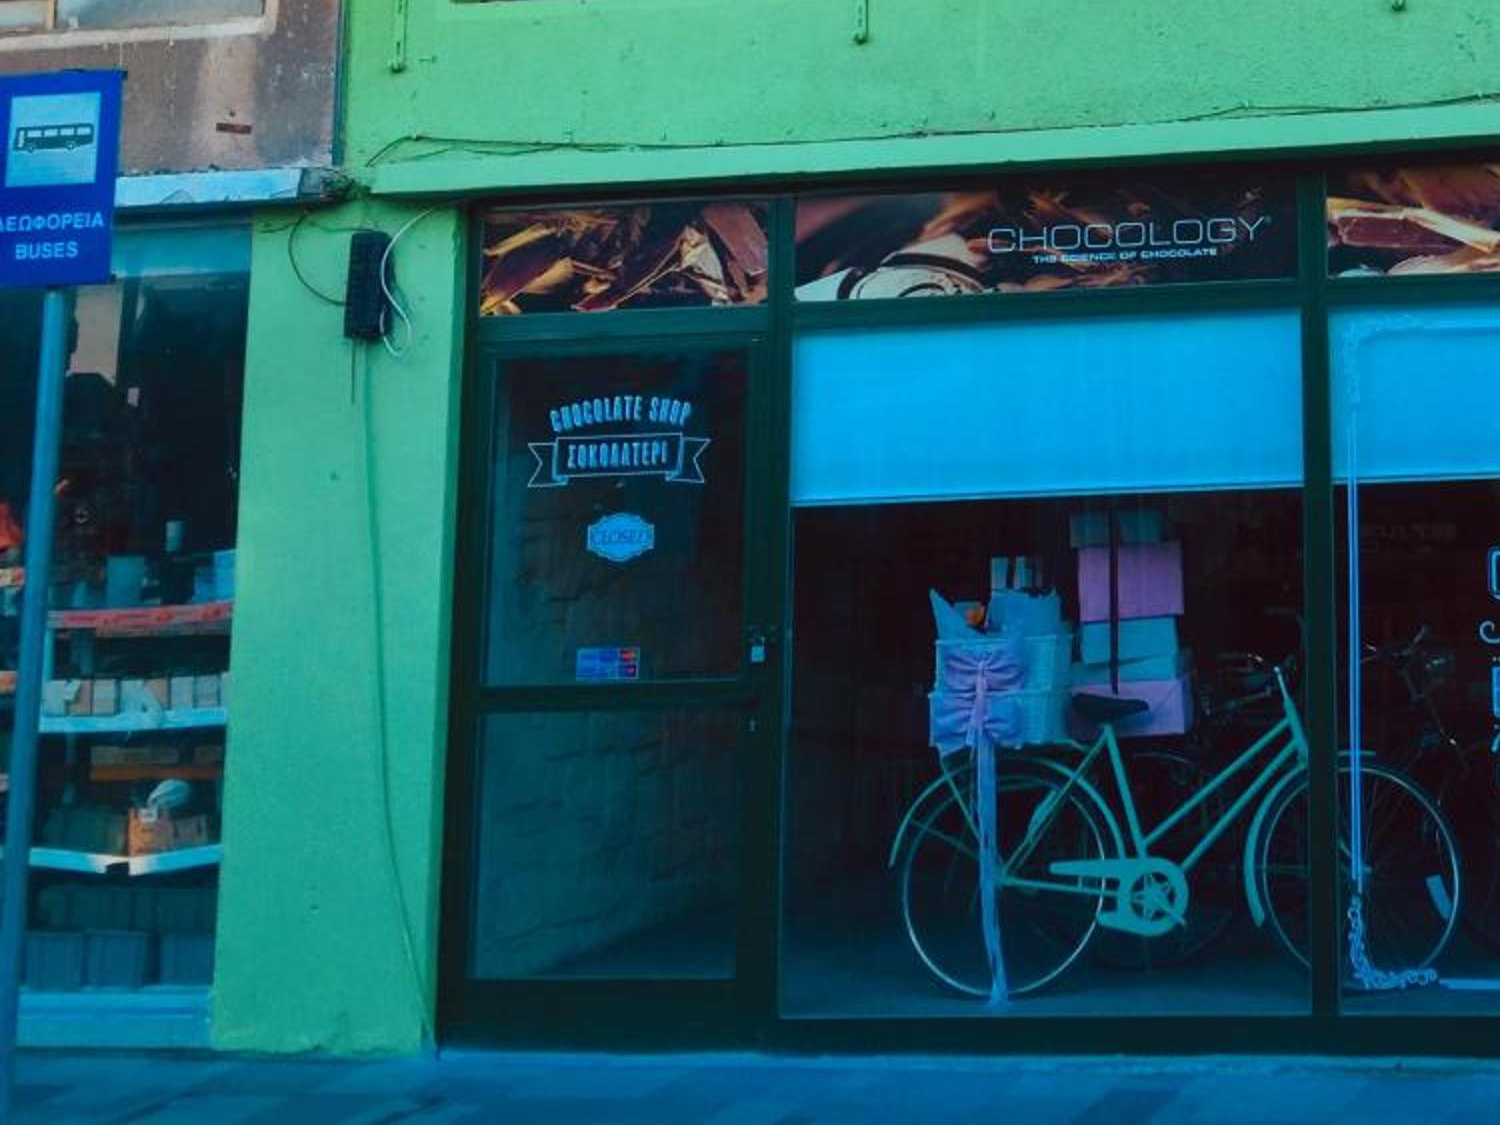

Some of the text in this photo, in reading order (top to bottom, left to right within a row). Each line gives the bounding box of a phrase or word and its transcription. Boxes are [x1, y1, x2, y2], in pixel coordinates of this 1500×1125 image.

[988, 216, 1265, 253] CHOCOLOGY
[15, 240, 79, 260] BUSES
[1032, 248, 1217, 265] THE SCIENCE OF CHOCOLATE
[550, 395, 692, 433] CHOCOLATE SHOP
